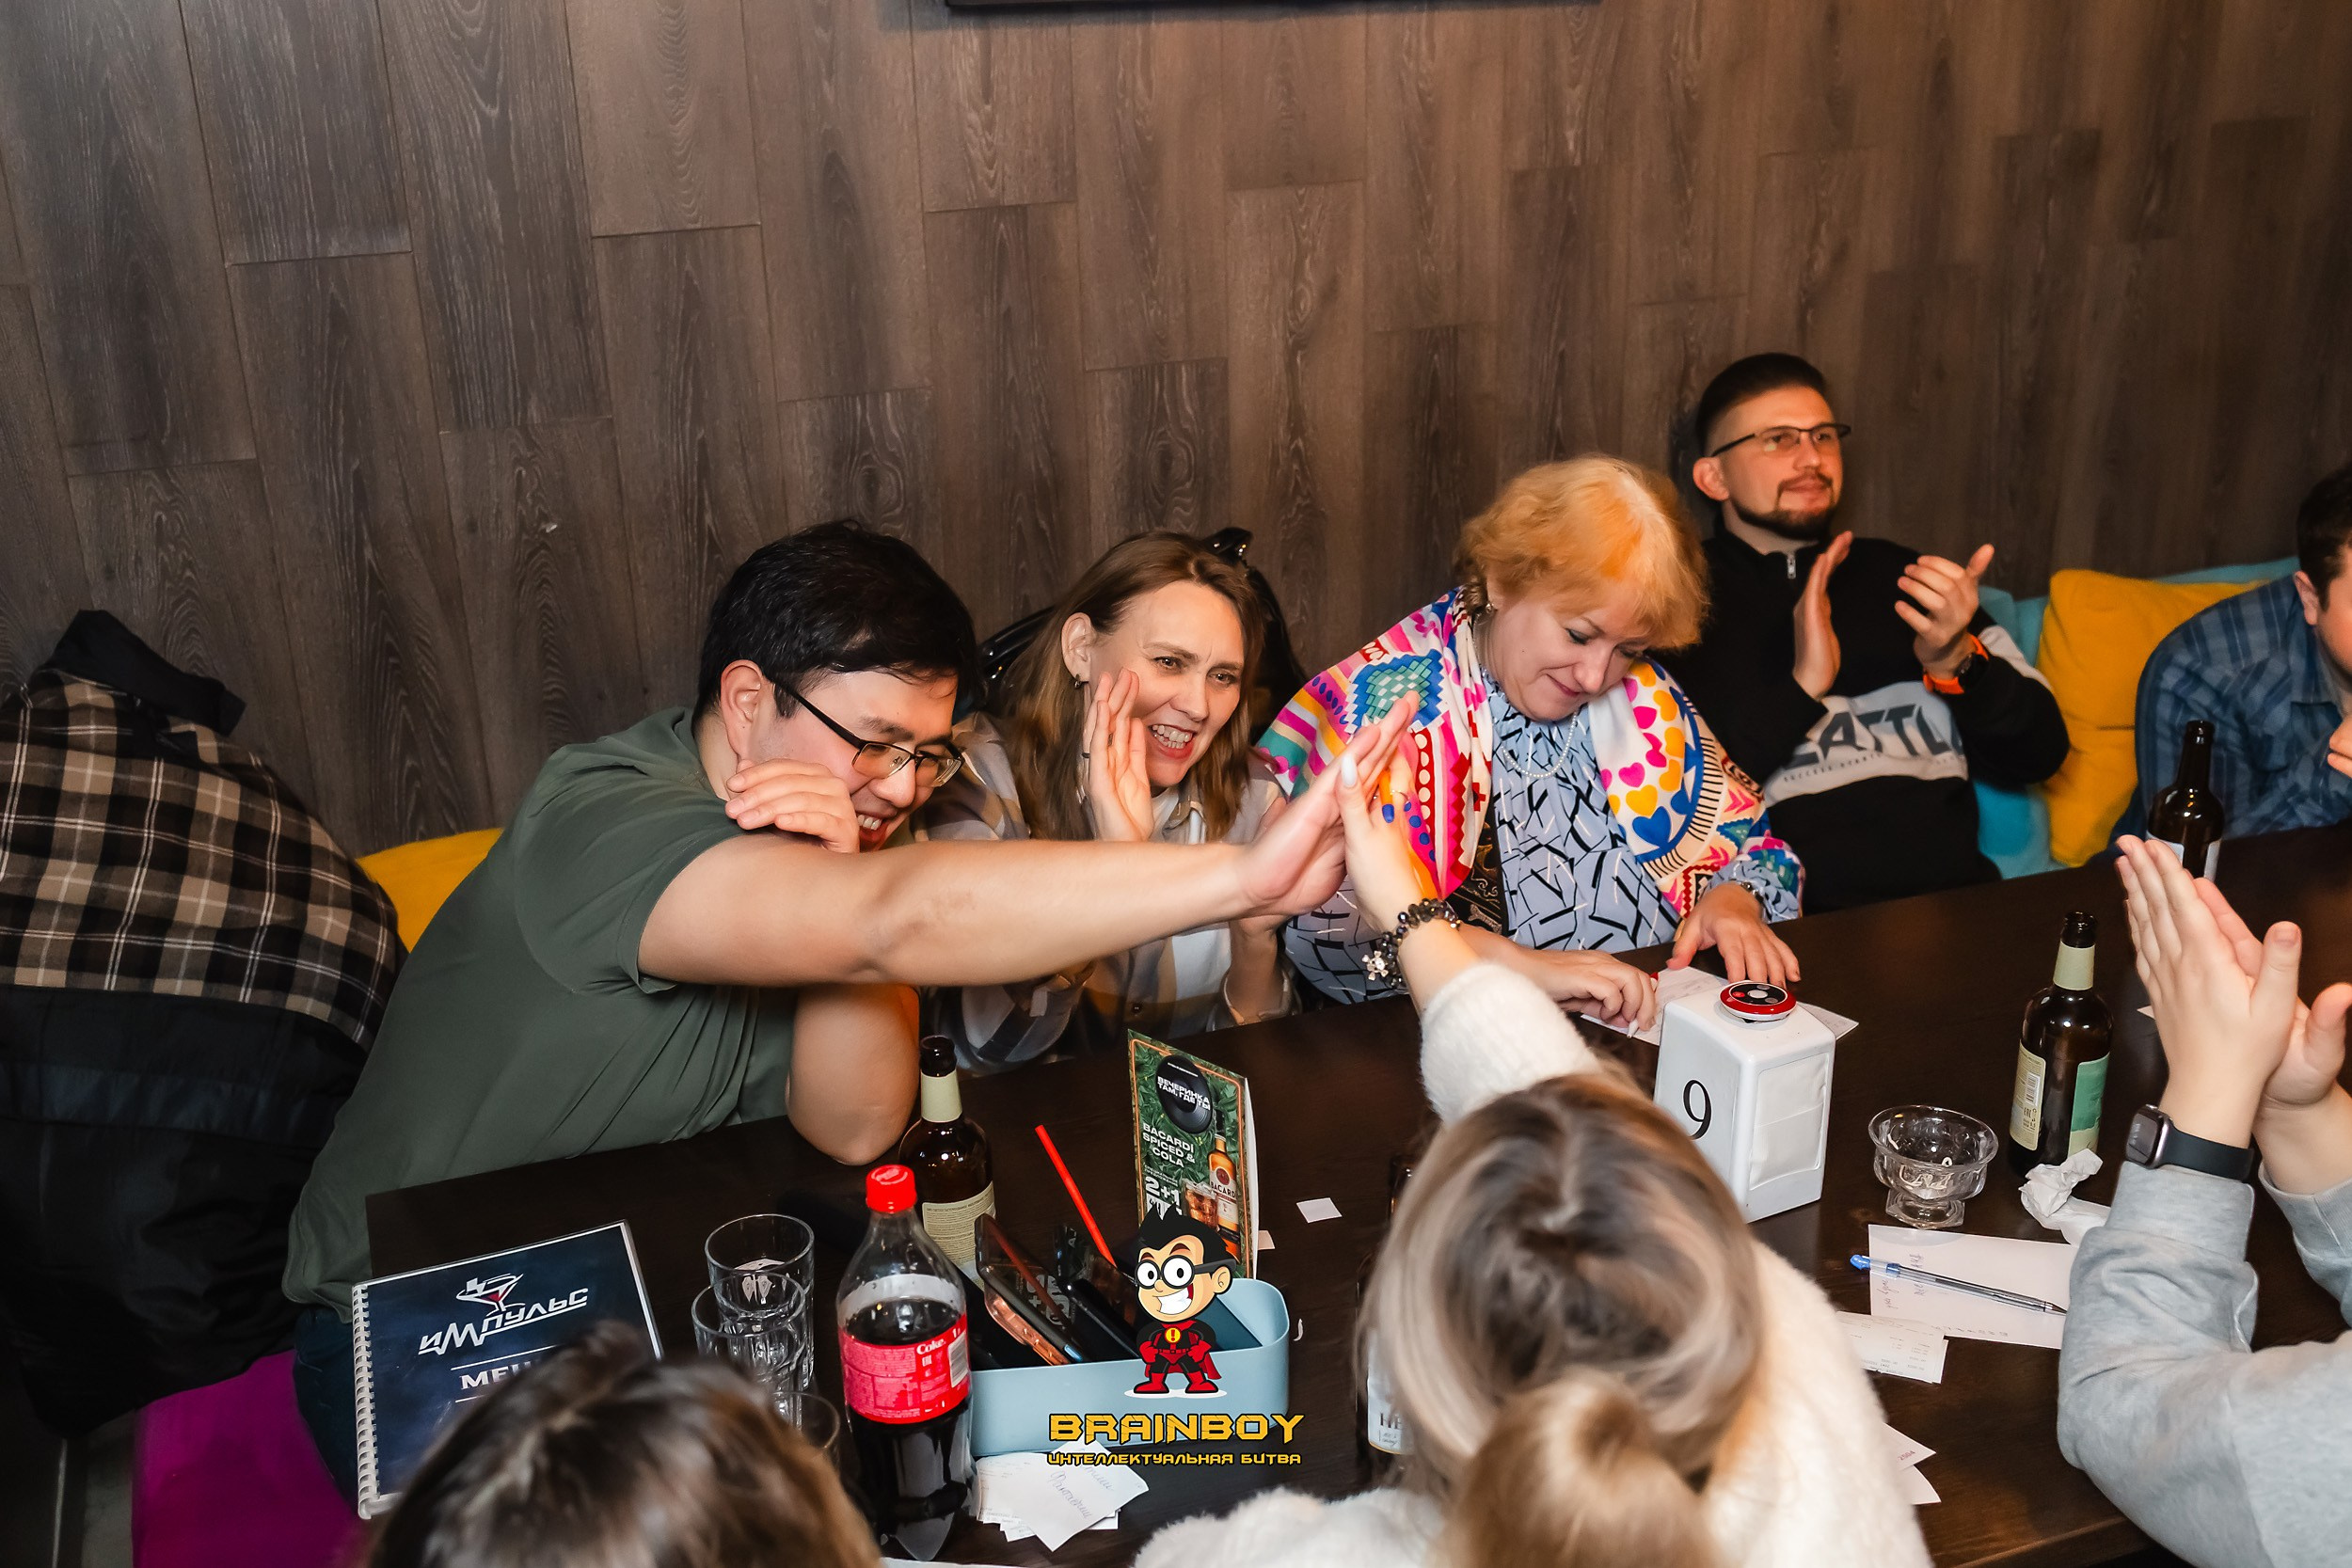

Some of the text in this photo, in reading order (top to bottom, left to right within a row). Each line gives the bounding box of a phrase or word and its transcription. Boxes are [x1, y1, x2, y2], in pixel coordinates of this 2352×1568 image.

[1787, 704, 1964, 769] ATTL
[1157, 1076, 1210, 1104] ВЕЧЕРИНКА
[1179, 1092, 1196, 1104] ГДЕ
[1197, 1100, 1211, 1111] ТЫ
[1682, 1079, 1712, 1140] 9
[1142, 1122, 1194, 1153] BACARDI
[1142, 1132, 1196, 1164] SPICED &
[1152, 1147, 1184, 1168] COLA
[1145, 1176, 1180, 1206] 2+1
[1211, 1181, 1236, 1198] BACARD
[916, 1338, 946, 1354] Coke
